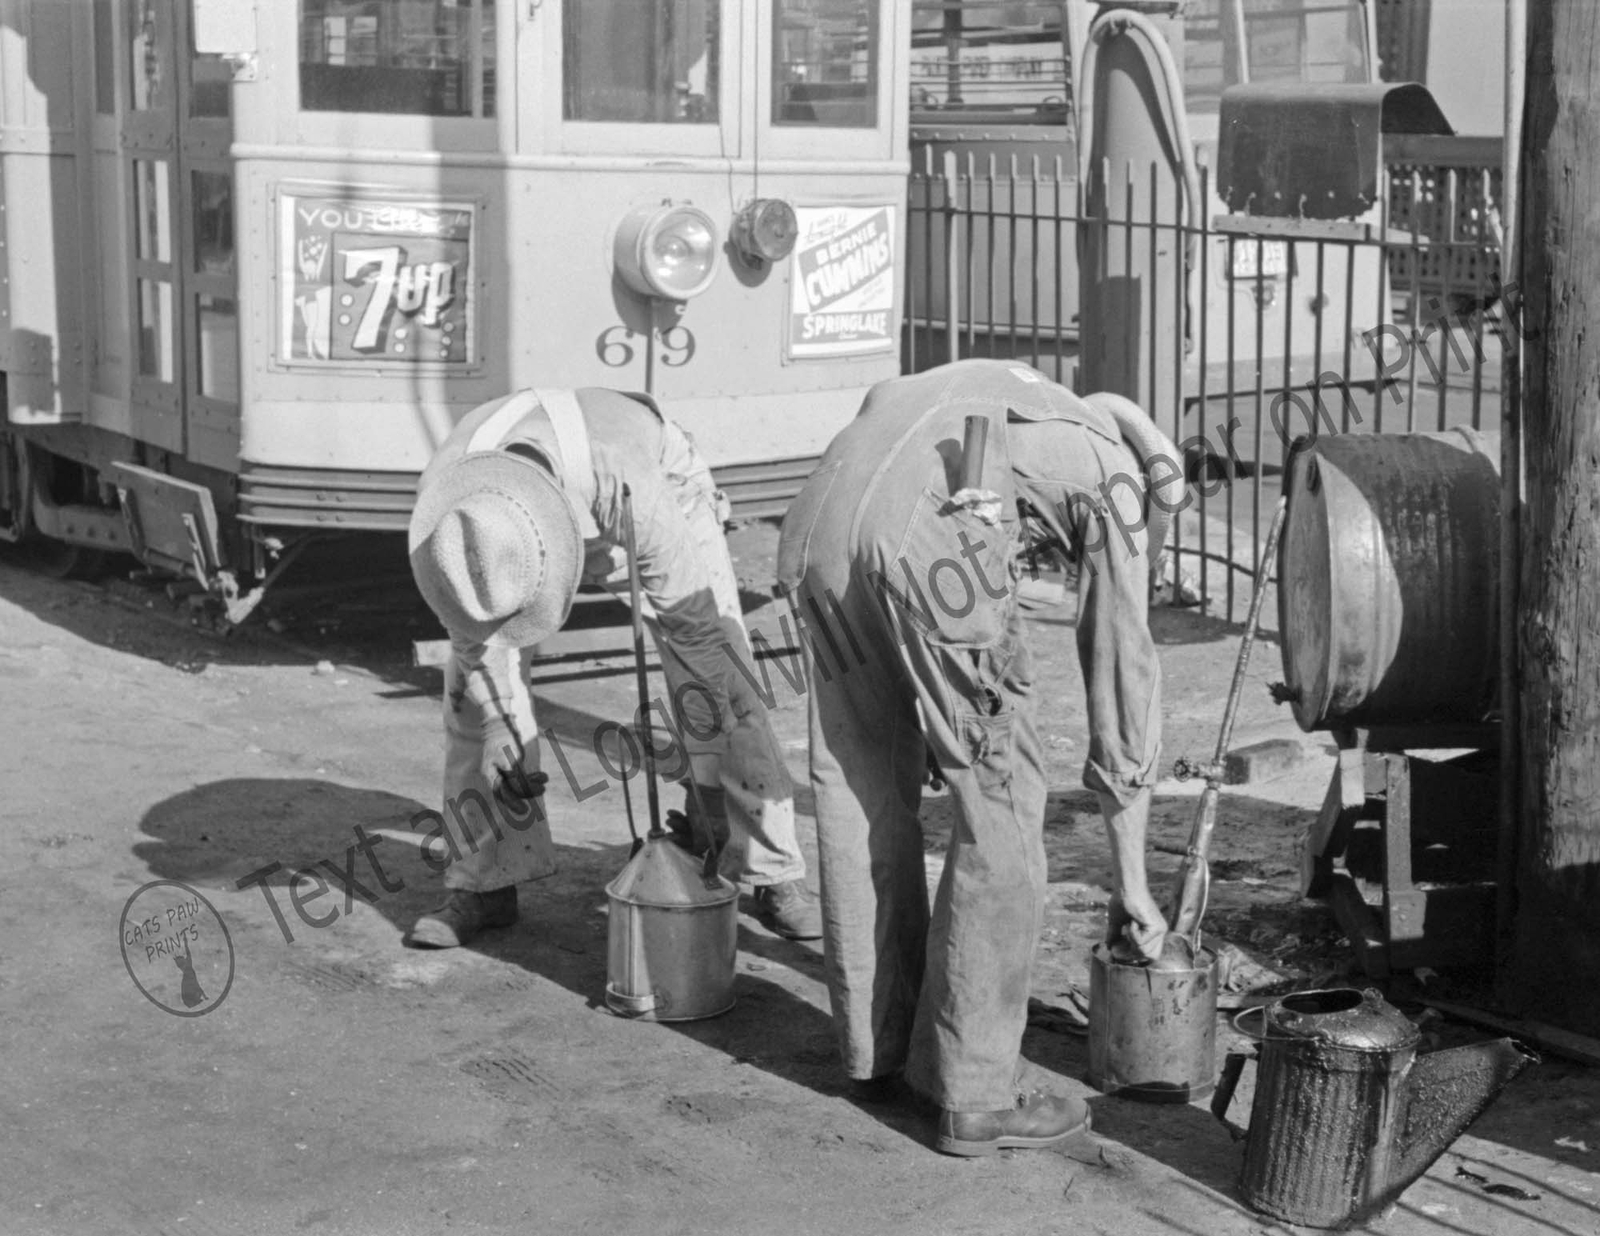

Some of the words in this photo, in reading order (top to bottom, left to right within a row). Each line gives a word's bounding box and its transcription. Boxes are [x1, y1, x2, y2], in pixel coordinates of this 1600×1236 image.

[298, 208, 362, 229] YOU
[815, 221, 877, 266] BERNIE
[802, 312, 886, 339] SPRINGLAKE
[595, 325, 696, 367] 69
